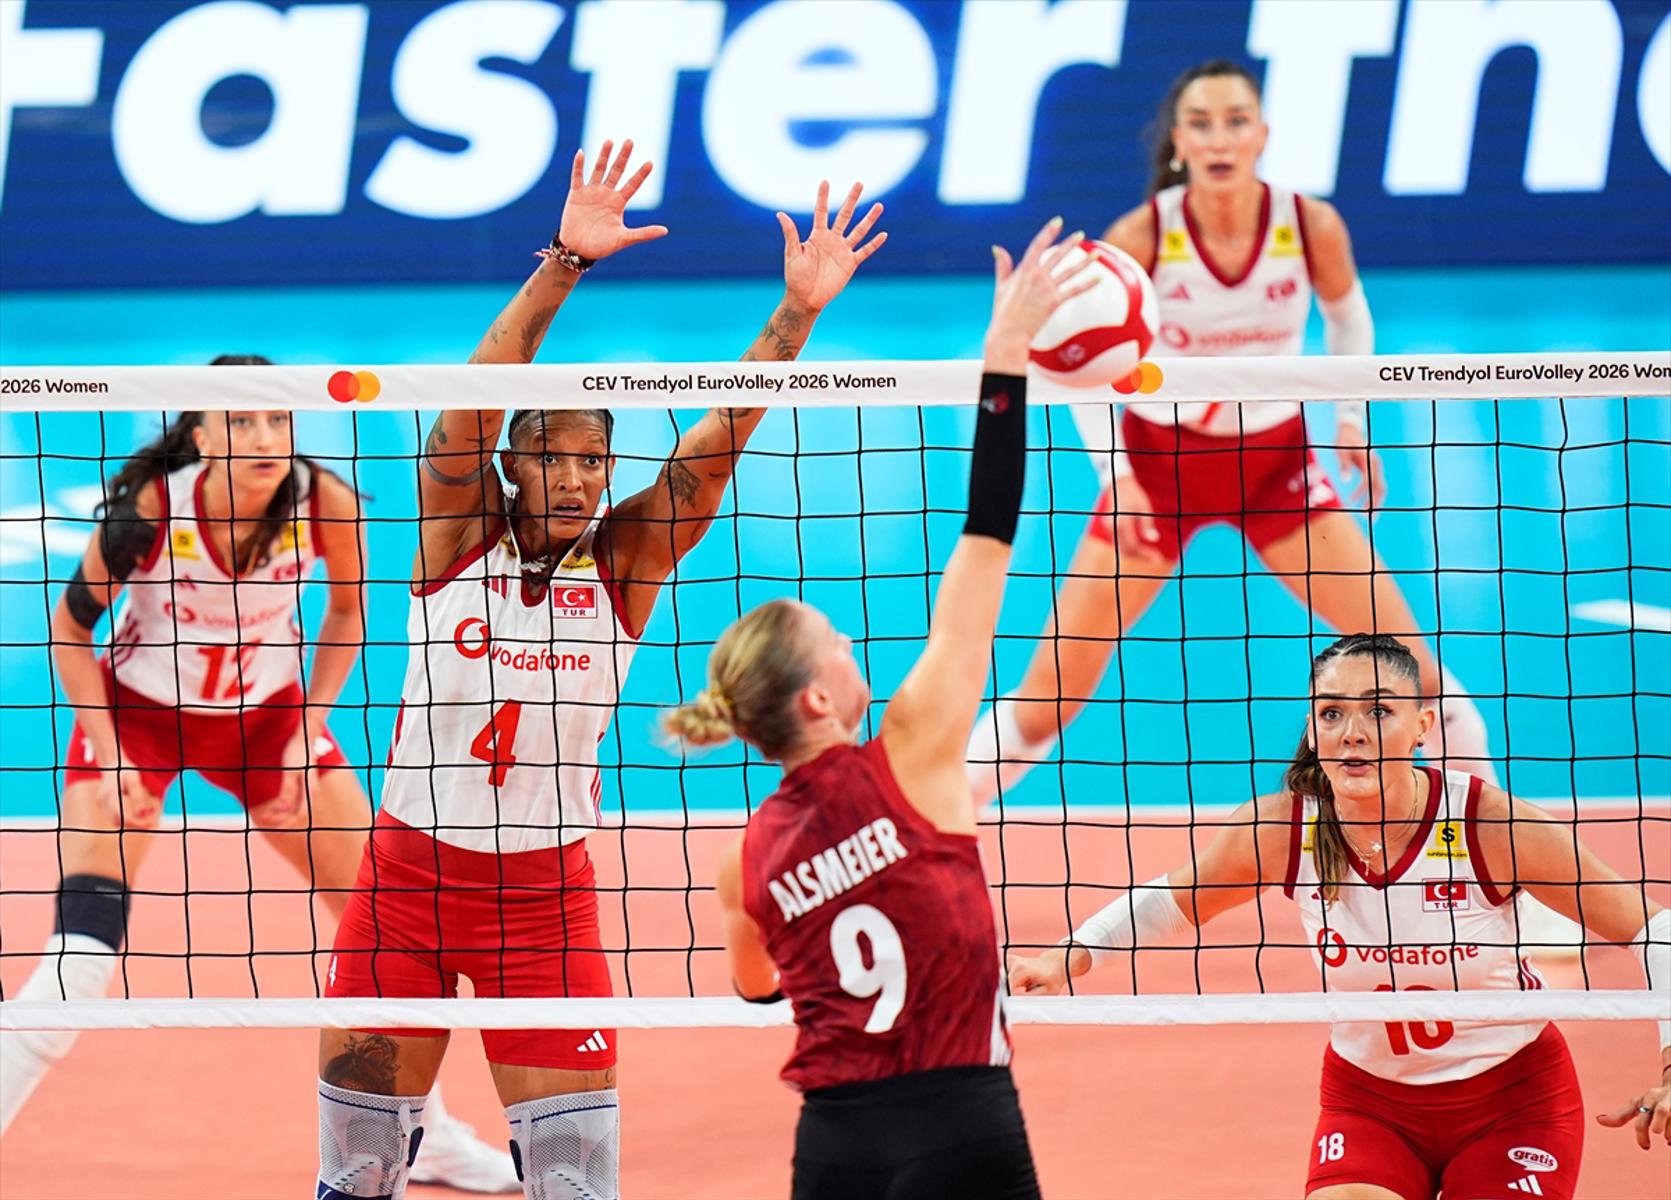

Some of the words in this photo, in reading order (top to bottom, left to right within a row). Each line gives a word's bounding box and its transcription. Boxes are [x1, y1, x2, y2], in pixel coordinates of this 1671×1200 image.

[1, 379, 41, 394] 2026
[45, 379, 109, 394] Women
[582, 376, 618, 391] CEV
[621, 375, 693, 394] Trendyol
[698, 374, 785, 393] EuroVolley
[788, 374, 829, 389] 2026
[833, 374, 897, 389] Women
[1379, 366, 1415, 382] CEV
[1418, 366, 1491, 385] Trendyol
[1496, 365, 1584, 383] EuroVolley
[1588, 364, 1630, 380] 2026
[561, 608, 586, 616] TUR
[198, 639, 262, 700] 12
[491, 645, 591, 672] vodafone
[470, 698, 522, 788] 4
[768, 817, 909, 922] ALSMEIER
[1434, 901, 1458, 909] TUR
[1355, 942, 1479, 966] vodafone
[829, 904, 908, 1034] 9
[1318, 1132, 1345, 1165] 18
[1513, 1149, 1555, 1168] gratis
